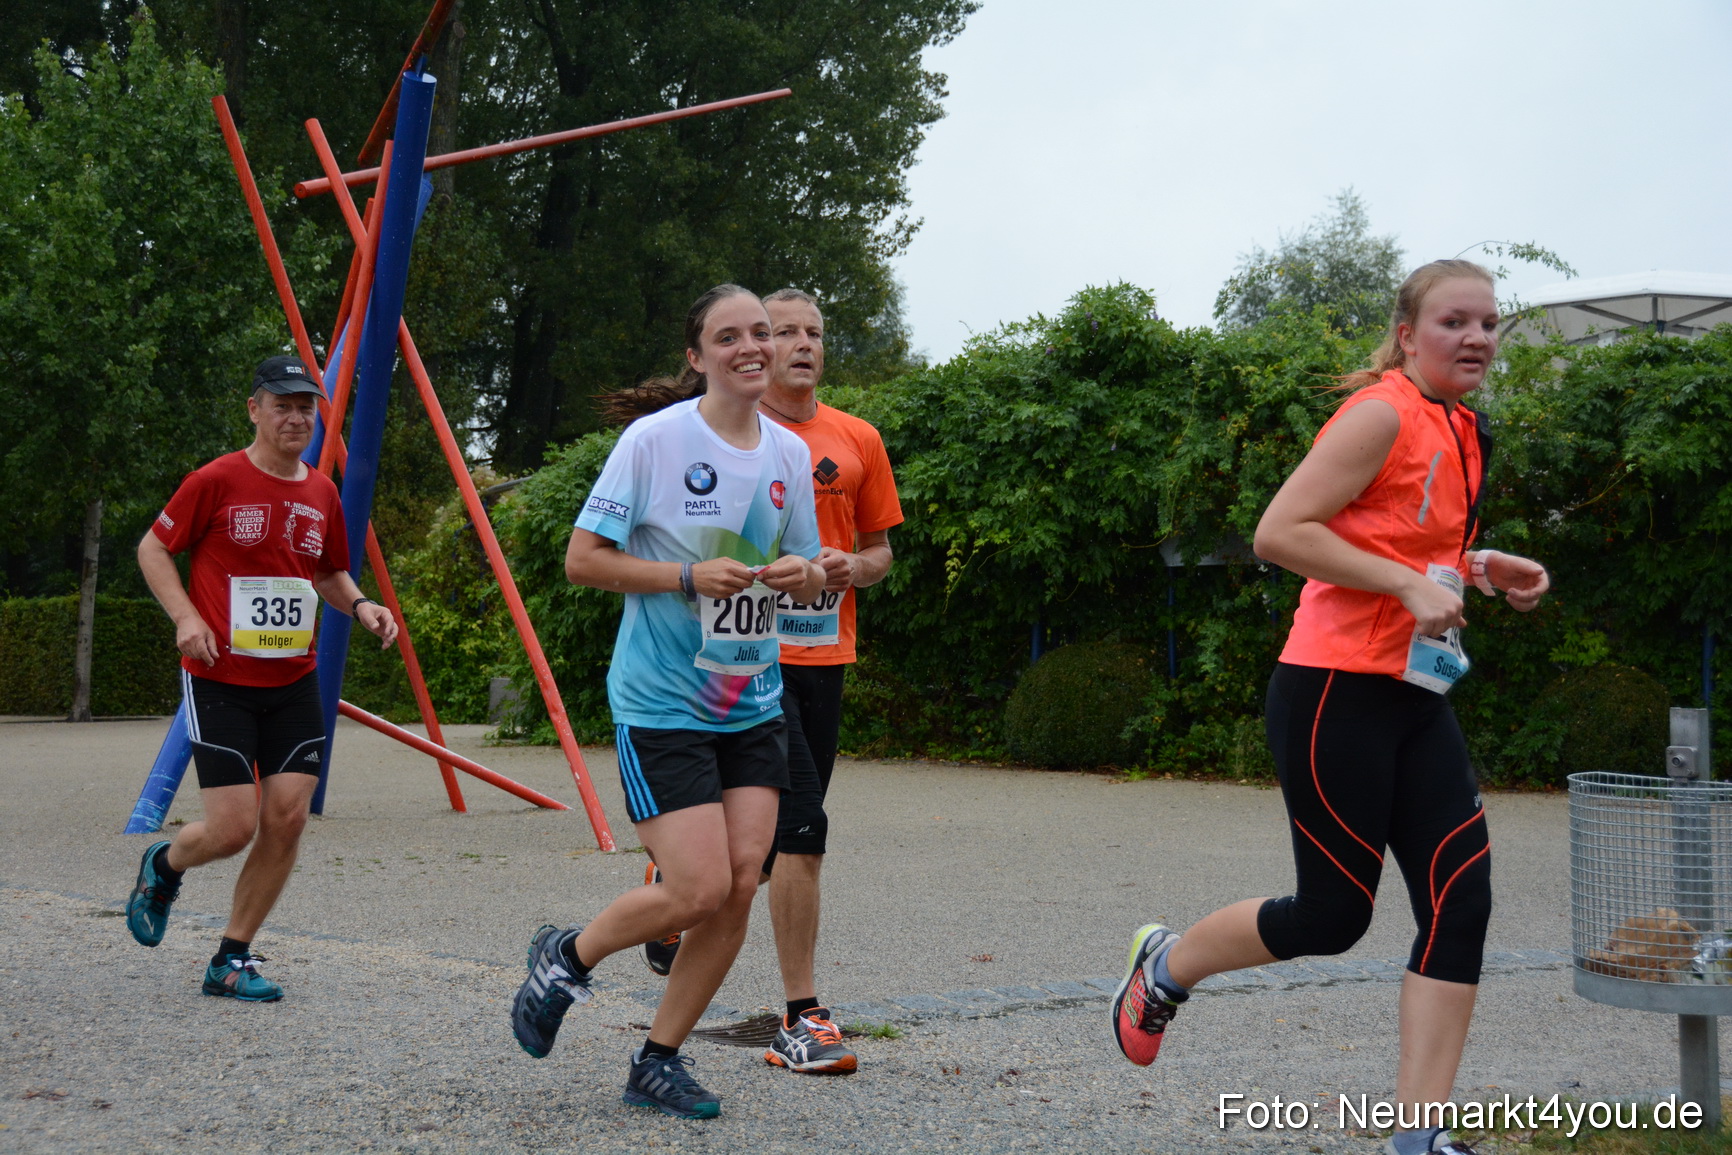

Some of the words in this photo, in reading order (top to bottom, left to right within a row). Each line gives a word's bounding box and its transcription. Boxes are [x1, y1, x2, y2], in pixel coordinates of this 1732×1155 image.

[589, 496, 630, 519] BOCK
[685, 500, 721, 510] PARTL
[234, 516, 265, 524] WIEDER
[235, 510, 265, 518] IMMER
[685, 509, 722, 517] Neumarkt
[235, 523, 262, 533] NEU
[251, 597, 302, 627] 335
[713, 595, 775, 635] 2080
[781, 619, 826, 634] Michael
[259, 634, 293, 648] Holger
[734, 646, 760, 661] Julia
